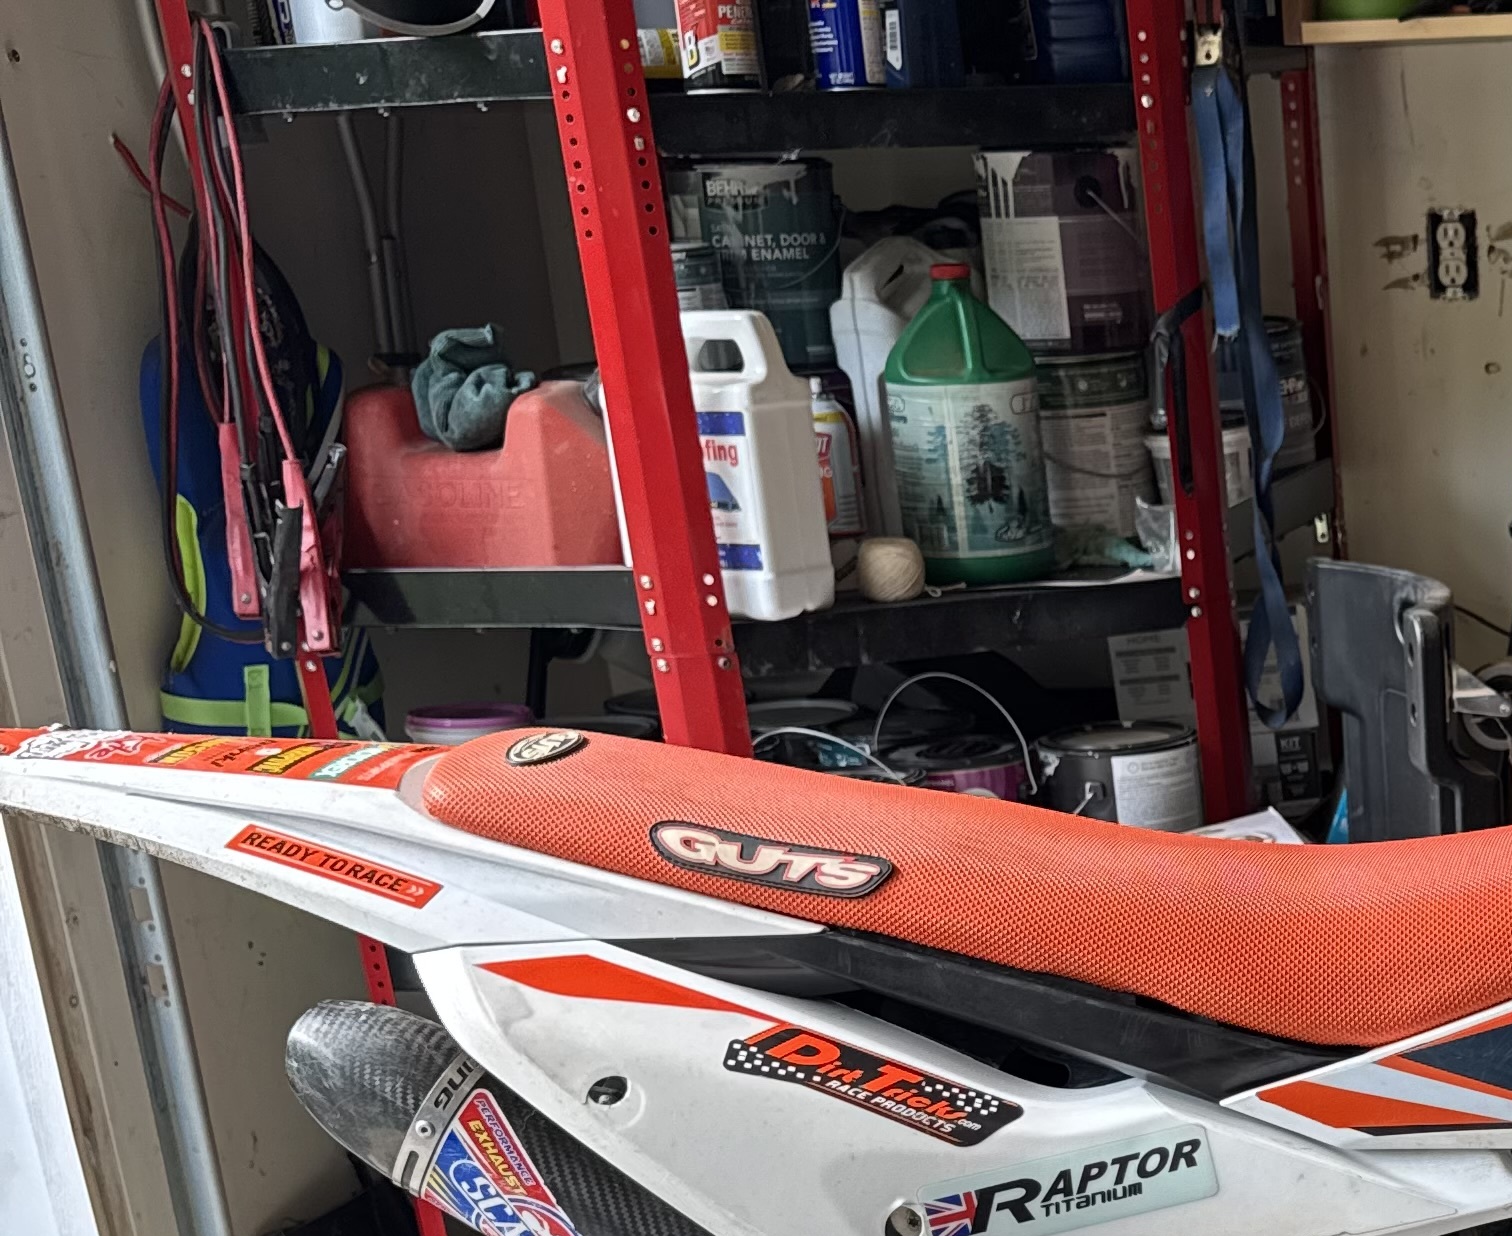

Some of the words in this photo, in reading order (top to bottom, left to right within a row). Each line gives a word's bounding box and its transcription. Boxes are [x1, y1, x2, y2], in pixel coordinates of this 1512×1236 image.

[711, 234, 776, 248] CANET,
[780, 233, 817, 246] DOOR
[752, 249, 809, 261] ENAMEL
[241, 829, 319, 866] READY
[317, 852, 347, 875] TO
[344, 859, 410, 894] RACE
[656, 826, 881, 888] GUTS
[431, 1053, 477, 1115] ING
[827, 1079, 869, 1102] RACE
[871, 1094, 956, 1135] PRODUCTS
[467, 1116, 528, 1200] EXHAUST
[472, 1097, 537, 1188] PERFORMANCE
[971, 1138, 1202, 1233] RAPTOR
